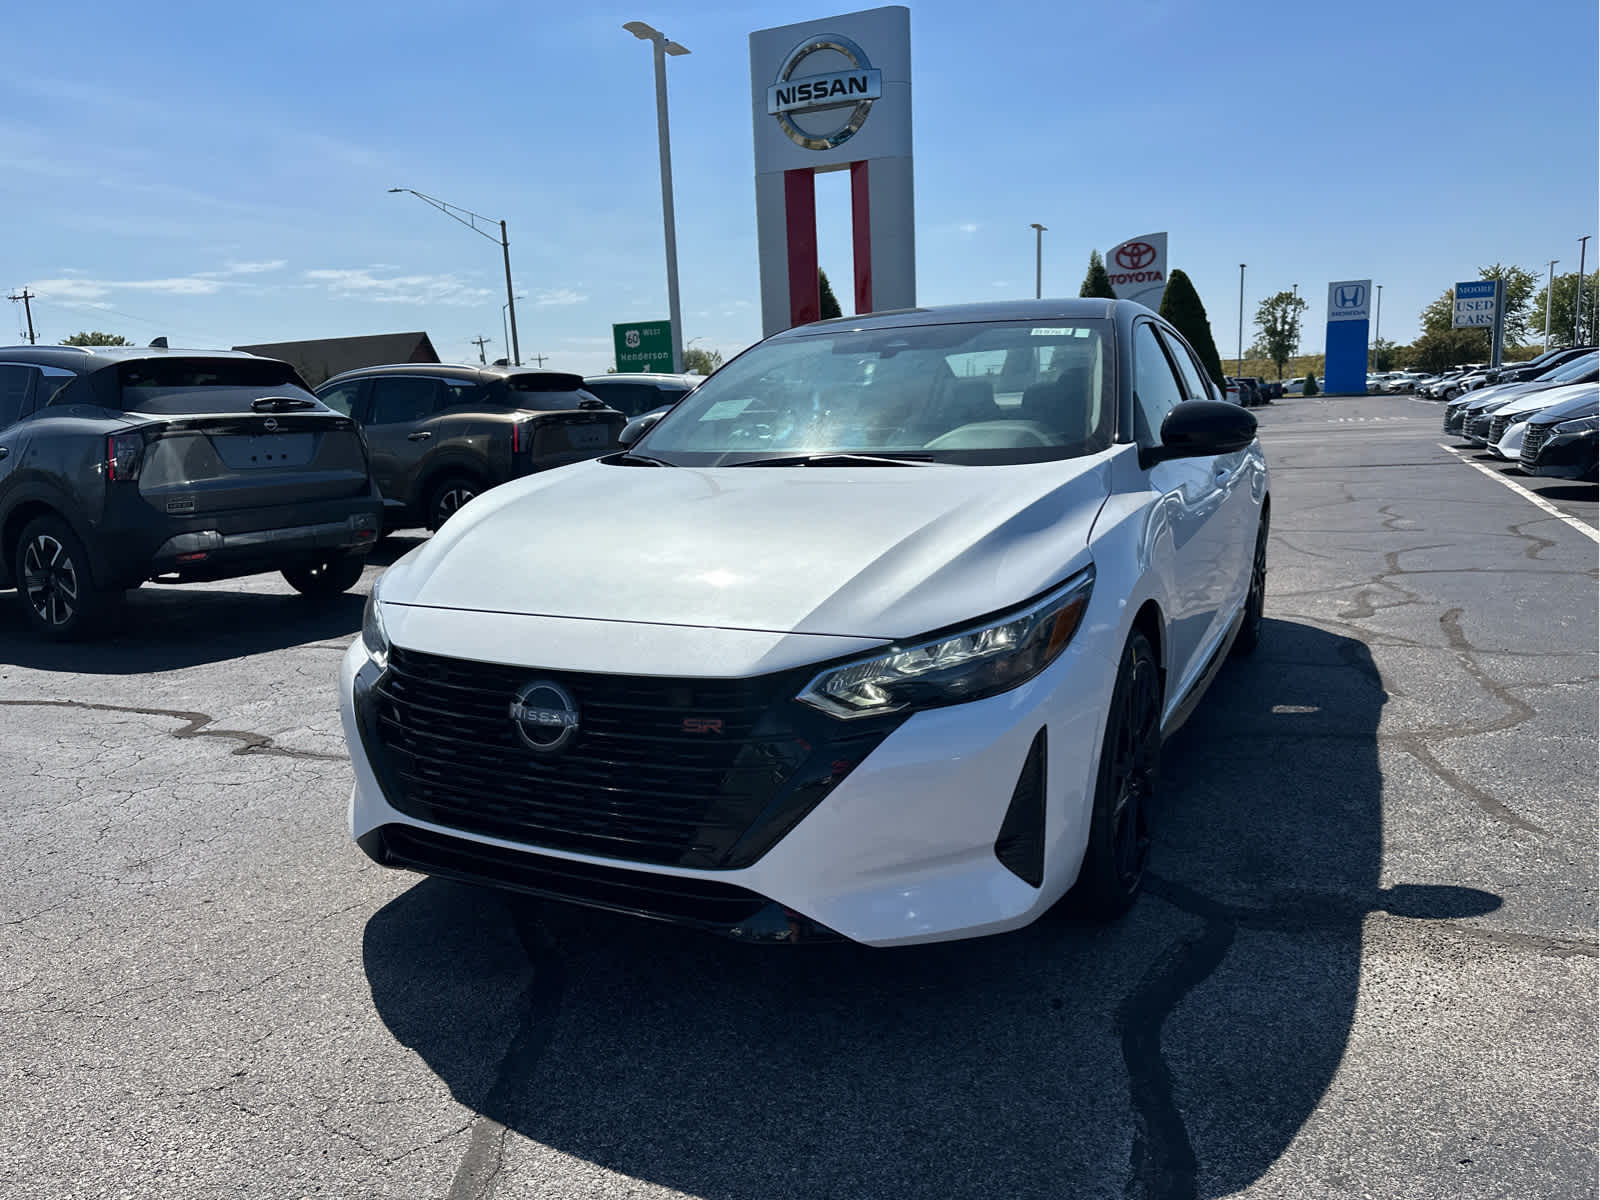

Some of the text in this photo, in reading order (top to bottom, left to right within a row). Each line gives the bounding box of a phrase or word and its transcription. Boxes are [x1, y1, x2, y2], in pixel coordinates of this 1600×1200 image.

[775, 76, 868, 107] NISSAN
[1109, 271, 1163, 285] TOYOTA
[1458, 285, 1494, 294] MOORE
[1456, 301, 1494, 312] USED
[1456, 314, 1493, 324] CARS
[627, 333, 639, 344] 60
[621, 352, 668, 360] Henderson
[511, 704, 577, 726] NISSAN
[683, 719, 723, 733] SR
